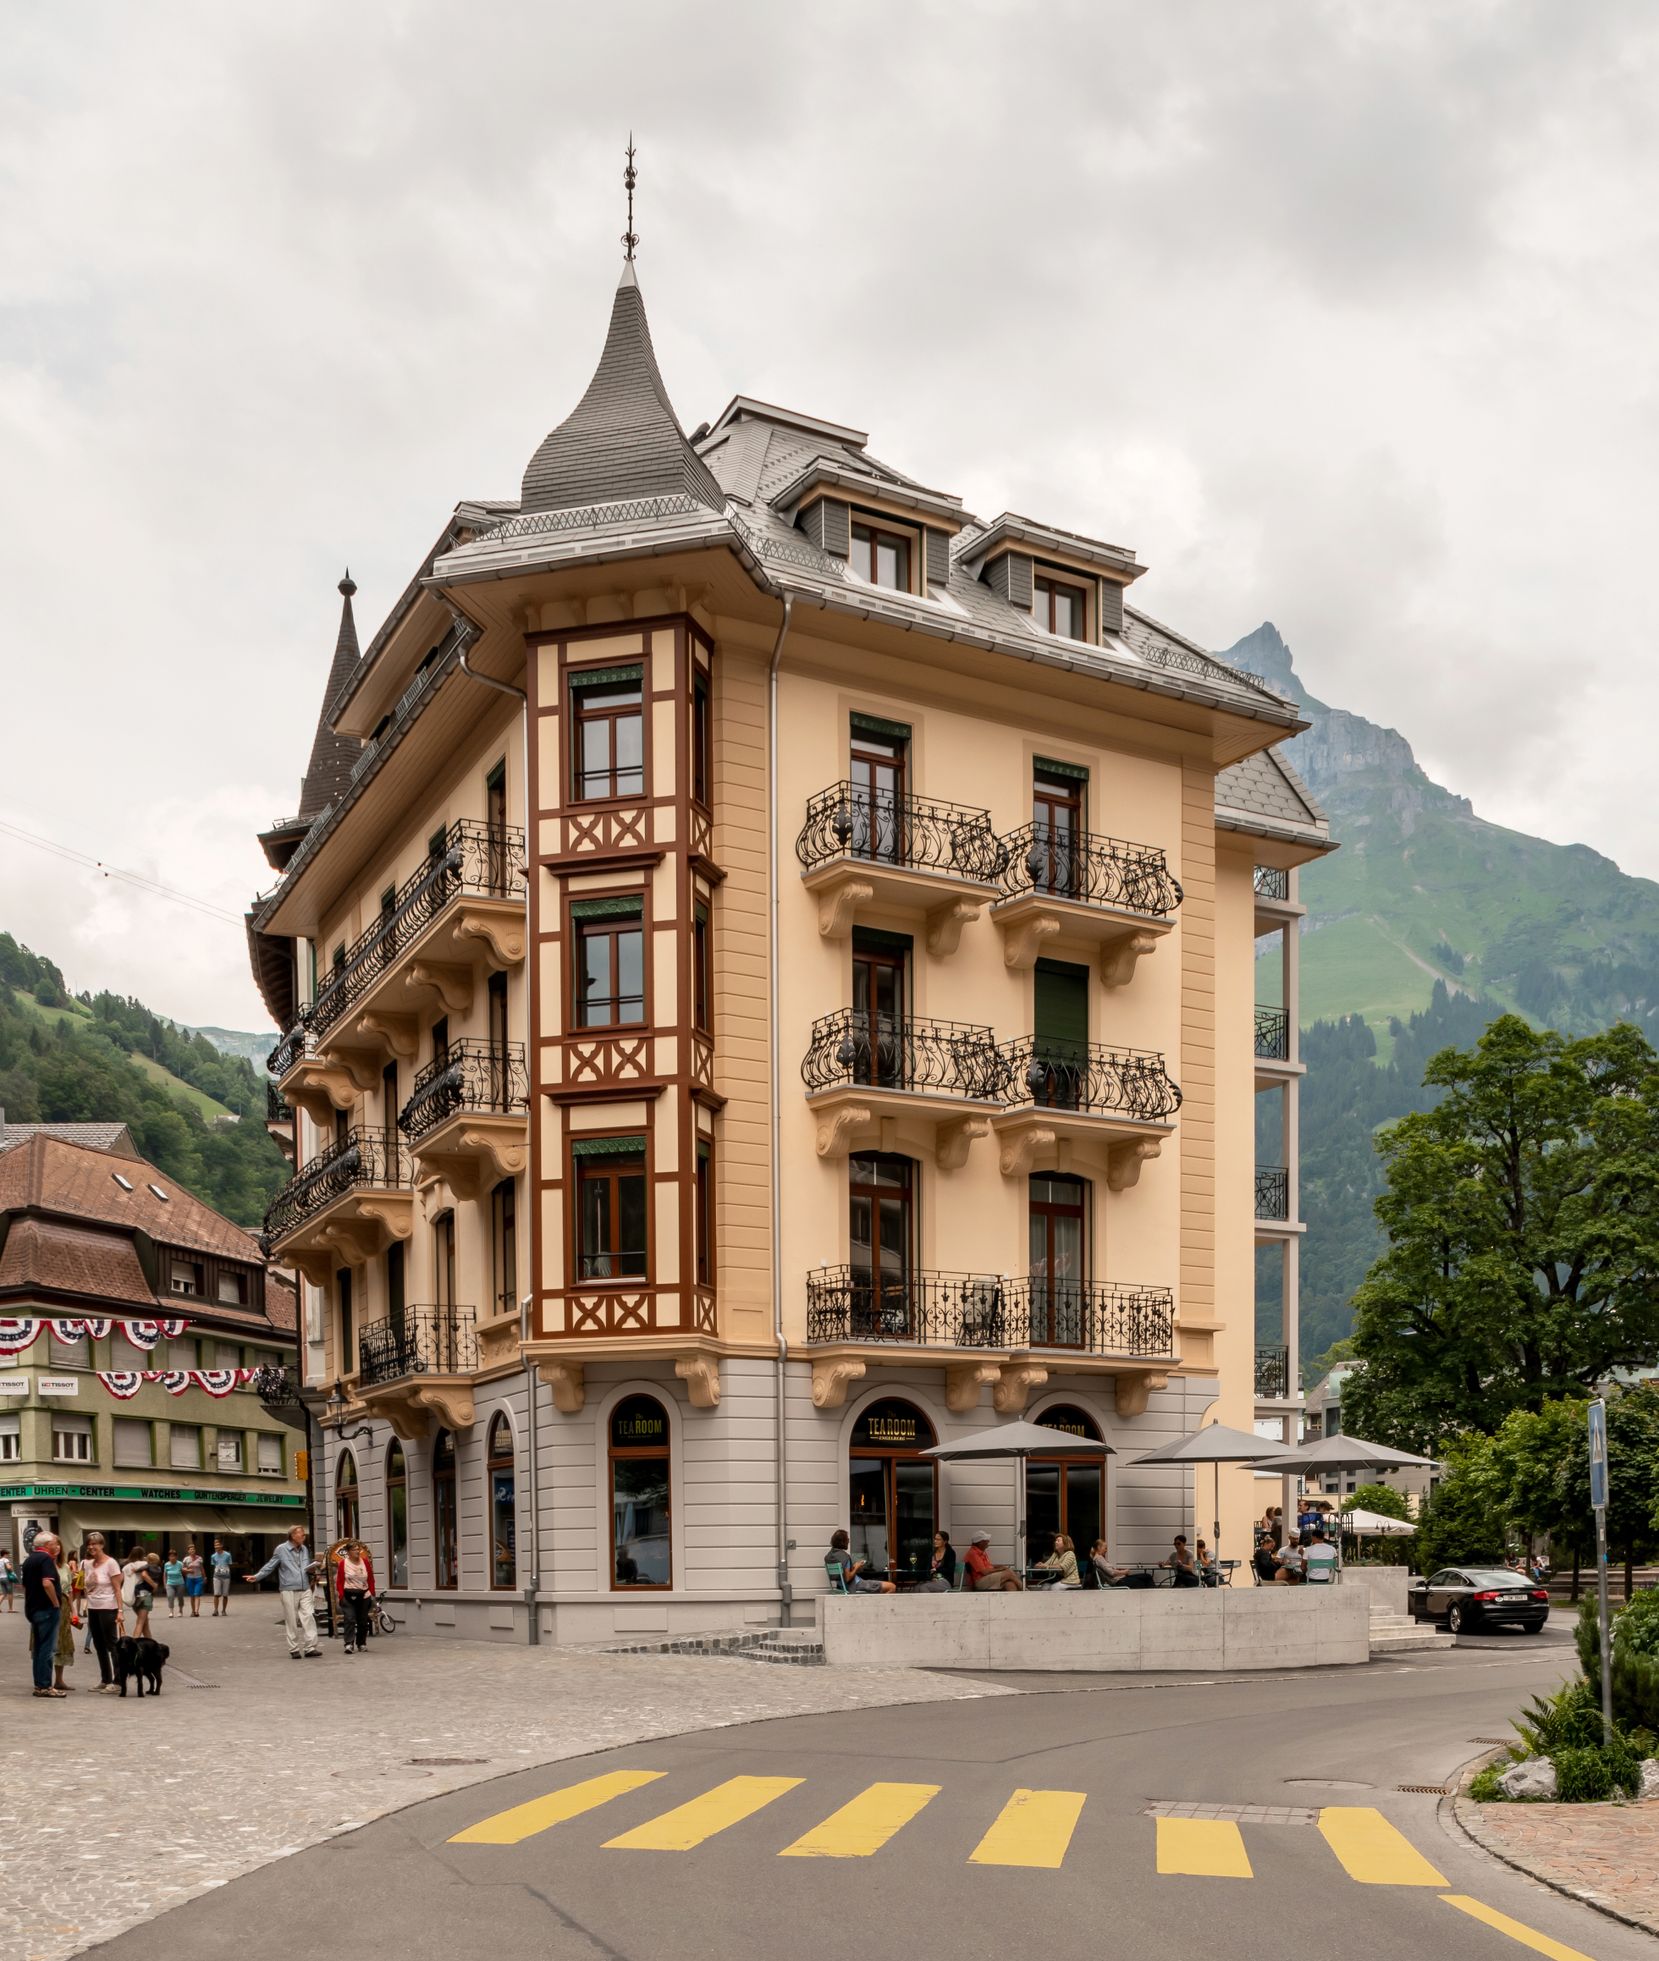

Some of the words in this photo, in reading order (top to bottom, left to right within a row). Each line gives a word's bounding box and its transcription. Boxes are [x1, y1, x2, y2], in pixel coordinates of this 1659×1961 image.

[33, 1486, 69, 1496] UHREN
[79, 1487, 115, 1497] CENTER
[141, 1489, 182, 1499] WATCHES
